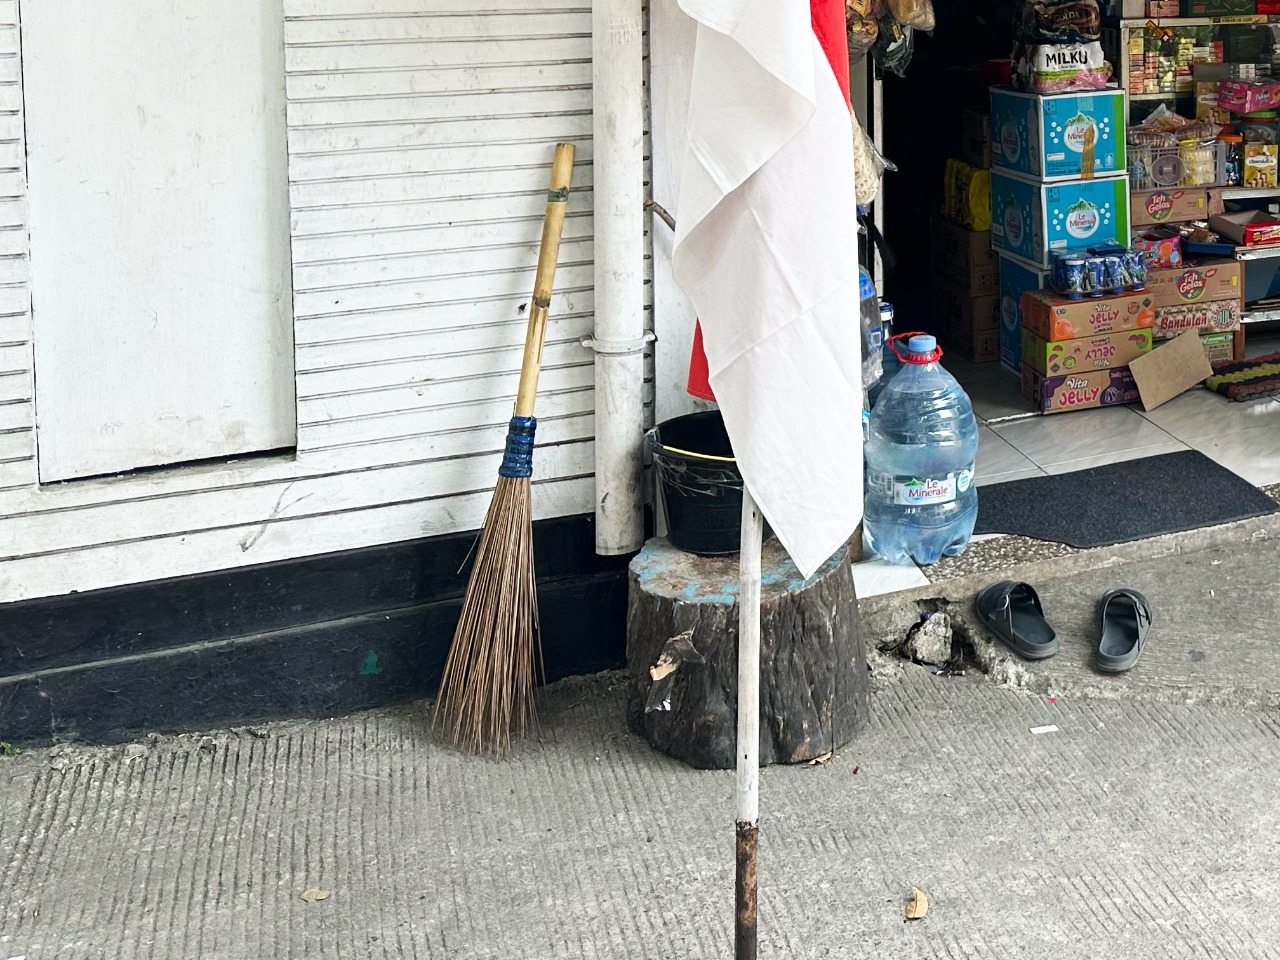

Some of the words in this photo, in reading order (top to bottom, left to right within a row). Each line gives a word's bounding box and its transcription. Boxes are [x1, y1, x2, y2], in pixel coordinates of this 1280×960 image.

[1045, 50, 1088, 68] MILKU
[1067, 132, 1085, 140] Mine
[1076, 126, 1085, 134] Le
[1148, 201, 1171, 214] Gelas
[1183, 272, 1198, 283] Teh
[1179, 280, 1203, 293] Gelas
[1160, 312, 1208, 330] Bandulan
[1066, 378, 1088, 389] Vita
[927, 479, 938, 489] Le
[908, 485, 948, 498] Minerale
